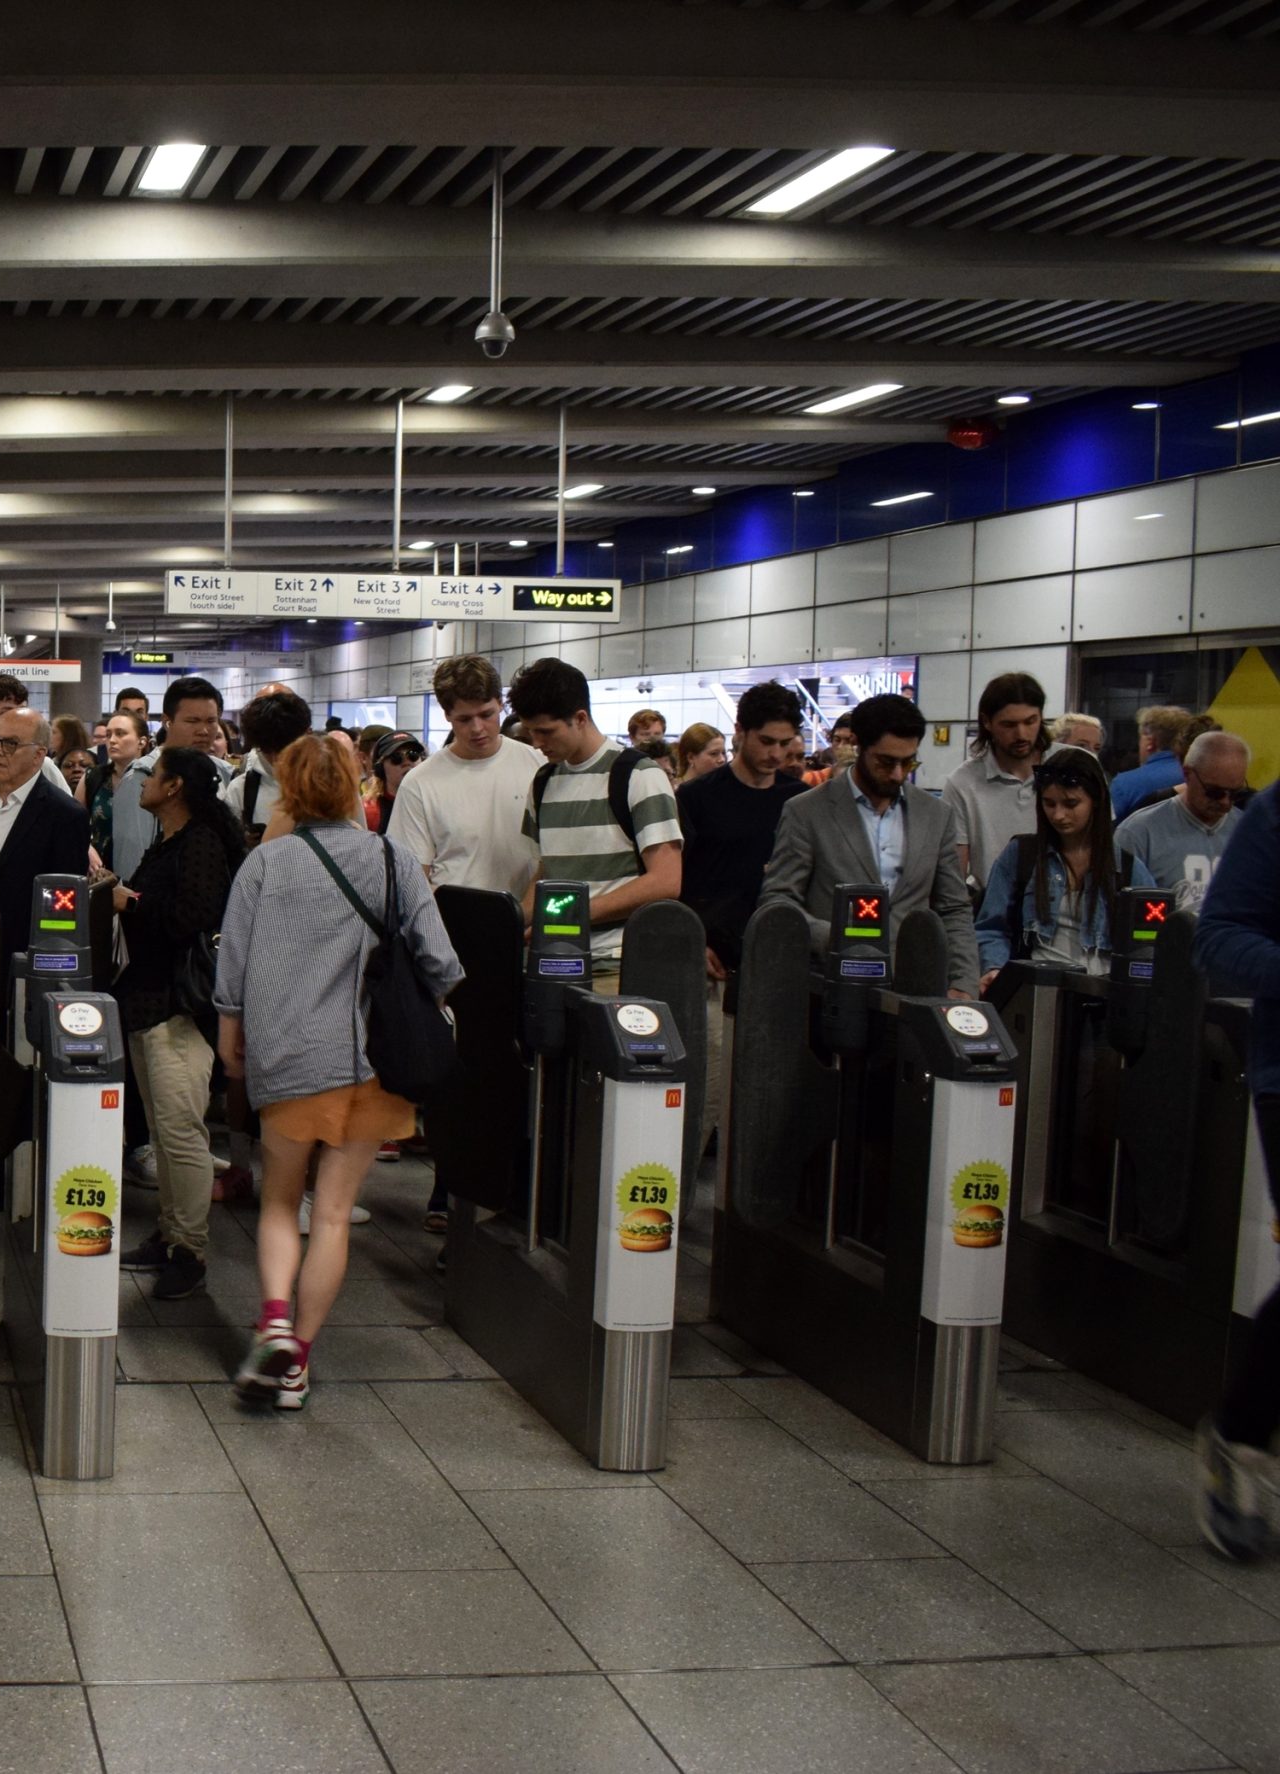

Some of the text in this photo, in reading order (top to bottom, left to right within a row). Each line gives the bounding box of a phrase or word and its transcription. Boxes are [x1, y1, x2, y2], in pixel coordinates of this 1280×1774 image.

[191, 576, 232, 589] Exit 1
[275, 578, 317, 591] Exit 2
[357, 580, 401, 593] Exit 3
[441, 582, 484, 594] Exit 4
[190, 593, 244, 601] Oxford Street
[276, 596, 317, 604] Tottenham
[354, 597, 401, 606] New Oxford
[532, 589, 594, 608] Way out
[189, 602, 236, 610] (south side)
[273, 604, 295, 612] Court
[431, 599, 484, 608] Charing Cross
[376, 606, 401, 614] Street
[465, 608, 483, 616] Road
[32, 667, 49, 676] line
[629, 1185, 667, 1204] £1.39
[963, 1182, 999, 1200] £1.39
[65, 1188, 106, 1207] £1.39
